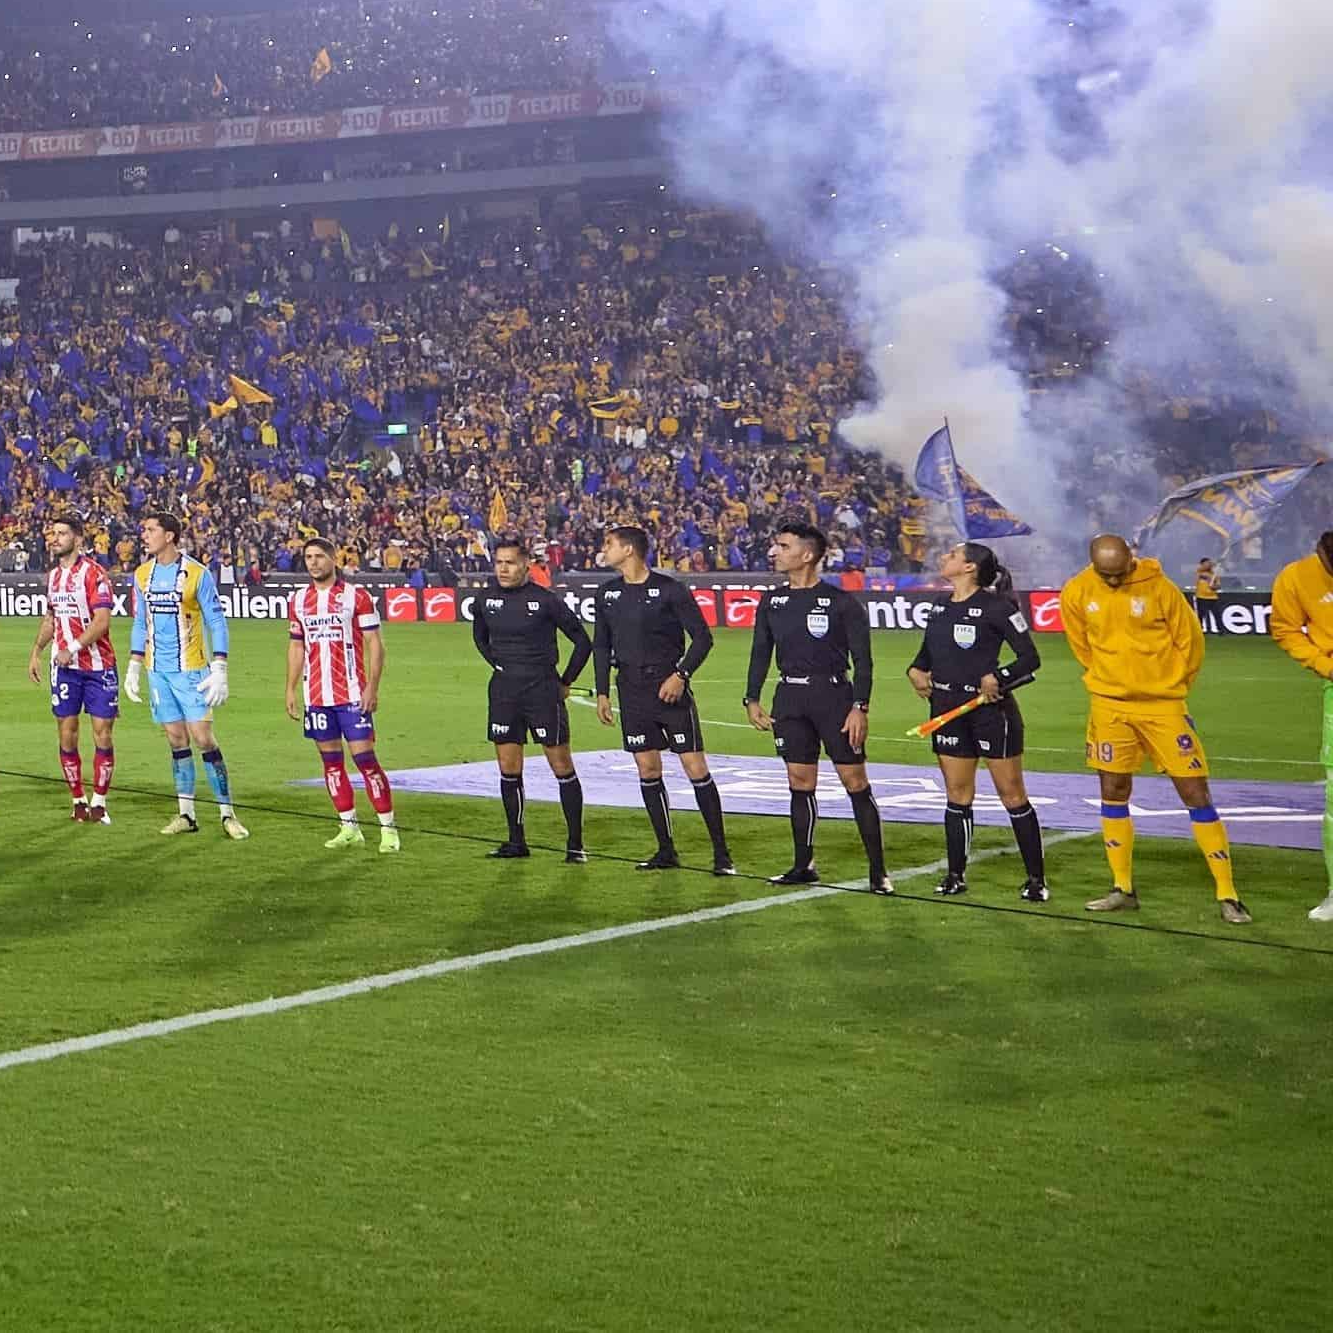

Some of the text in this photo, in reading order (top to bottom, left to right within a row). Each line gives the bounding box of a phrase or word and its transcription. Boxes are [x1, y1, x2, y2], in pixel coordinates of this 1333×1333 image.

[28, 133, 86, 154] TECATE
[145, 126, 203, 146] TECATE
[265, 116, 325, 138] TECATE
[388, 106, 451, 130] TECATE
[518, 94, 582, 116] TECATE
[59, 683, 70, 700] 2
[311, 712, 328, 730] 16
